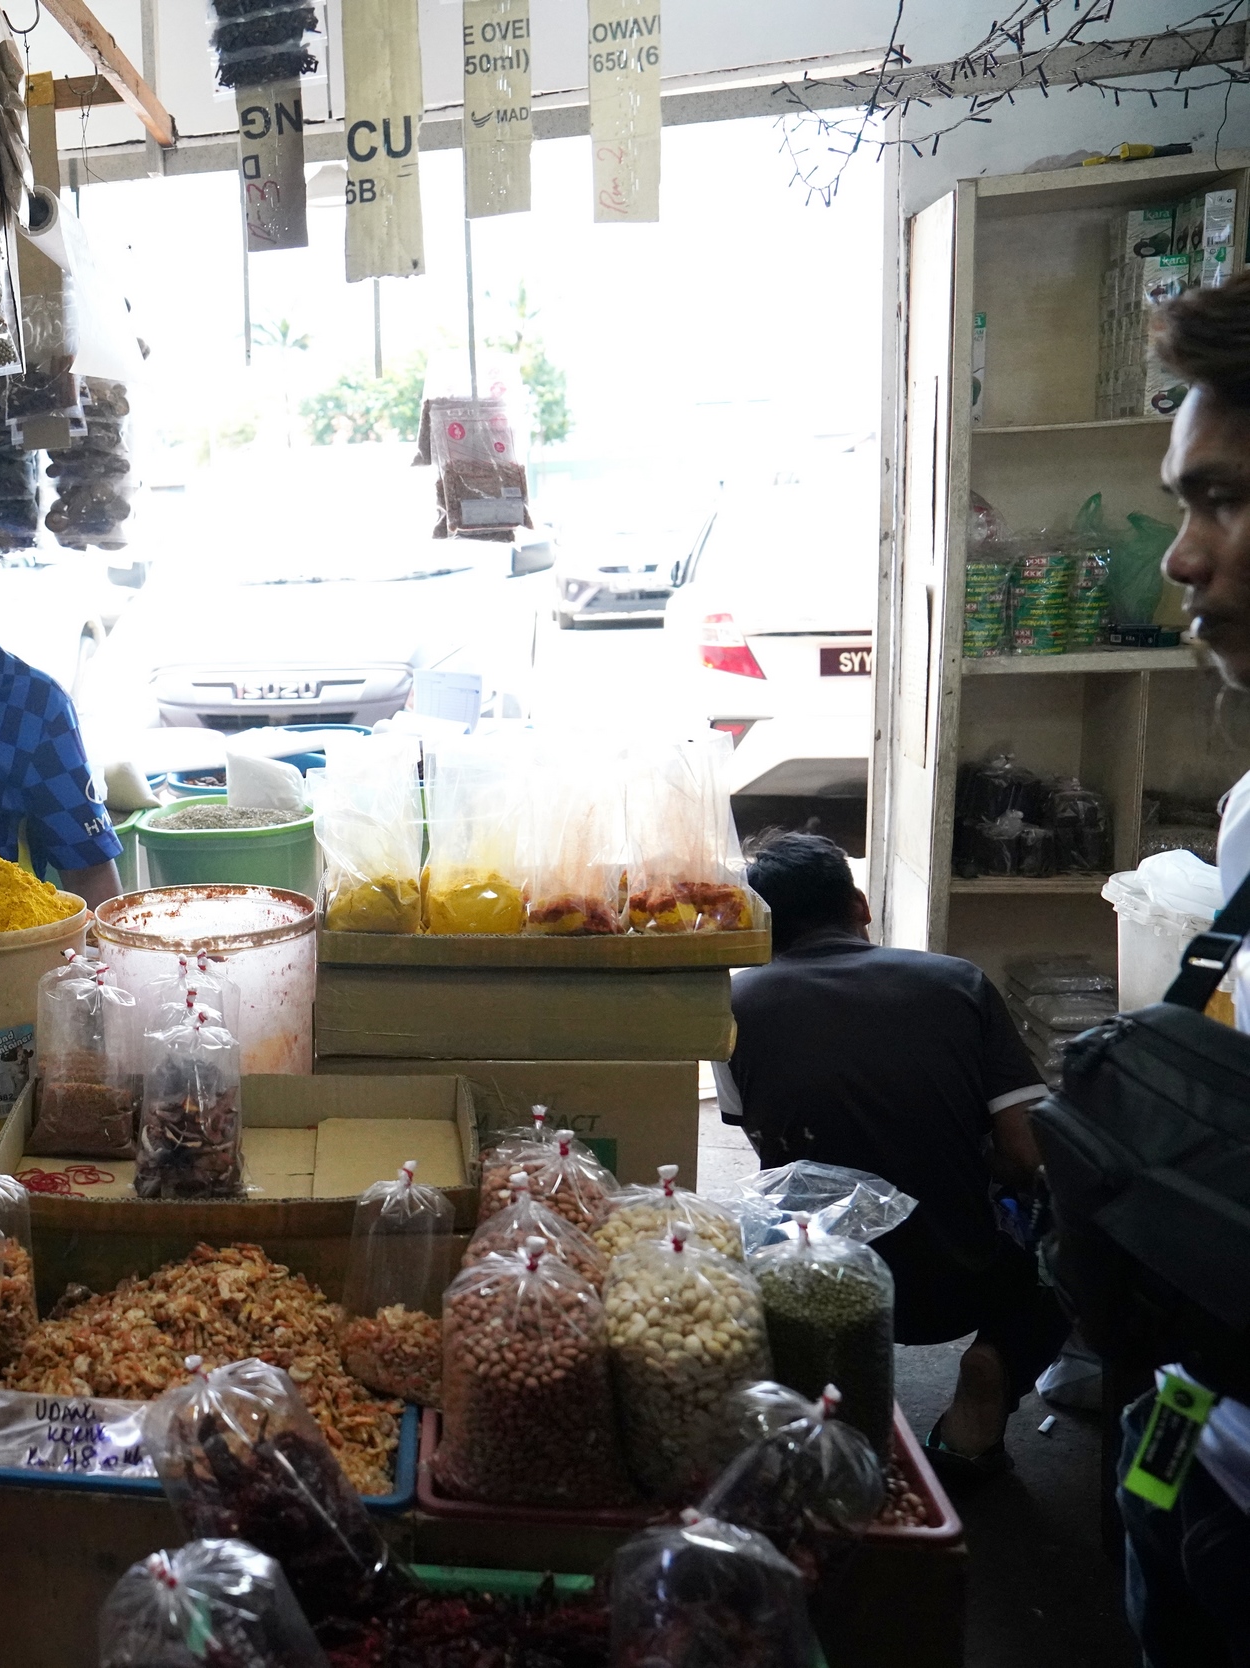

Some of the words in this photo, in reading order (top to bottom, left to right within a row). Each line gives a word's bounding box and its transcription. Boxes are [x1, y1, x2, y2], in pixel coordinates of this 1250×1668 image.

[481, 18, 530, 43] OVE
[589, 15, 661, 44] OWAV
[589, 50, 628, 73] 650
[347, 115, 412, 163] CU
[345, 178, 377, 205] 6B
[1144, 209, 1170, 220] kara
[1161, 255, 1187, 267] kara
[839, 651, 872, 673] SYY
[236, 680, 317, 699] ISUZU
[84, 810, 112, 837] HY
